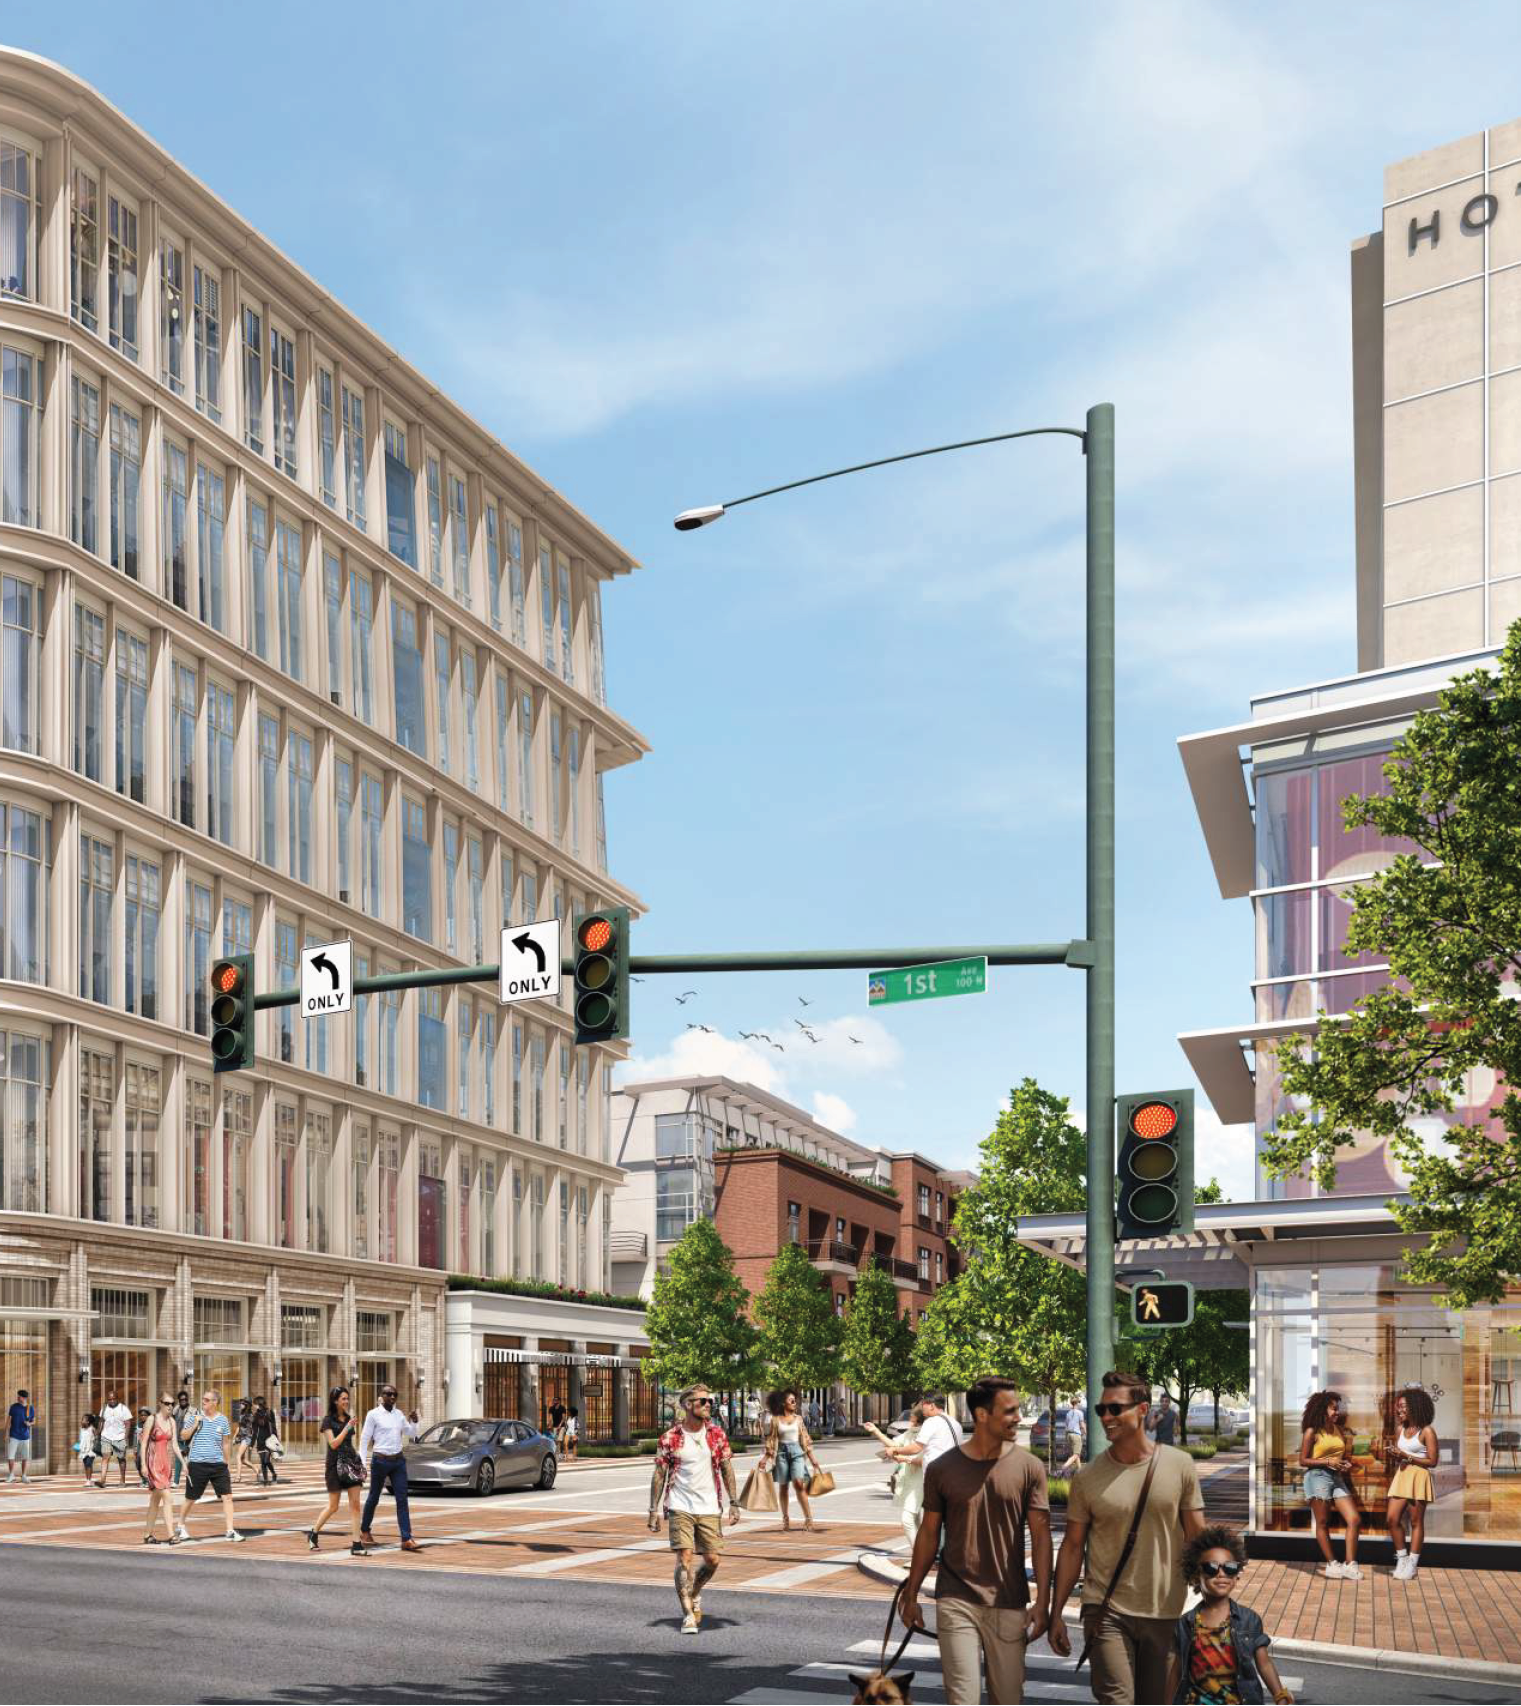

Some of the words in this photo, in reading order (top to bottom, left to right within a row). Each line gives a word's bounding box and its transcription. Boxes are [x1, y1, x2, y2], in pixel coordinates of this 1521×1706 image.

[1407, 182, 1521, 257] HO
[509, 975, 551, 994] ONLY
[904, 970, 937, 994] 1st
[308, 993, 344, 1010] ONLY
